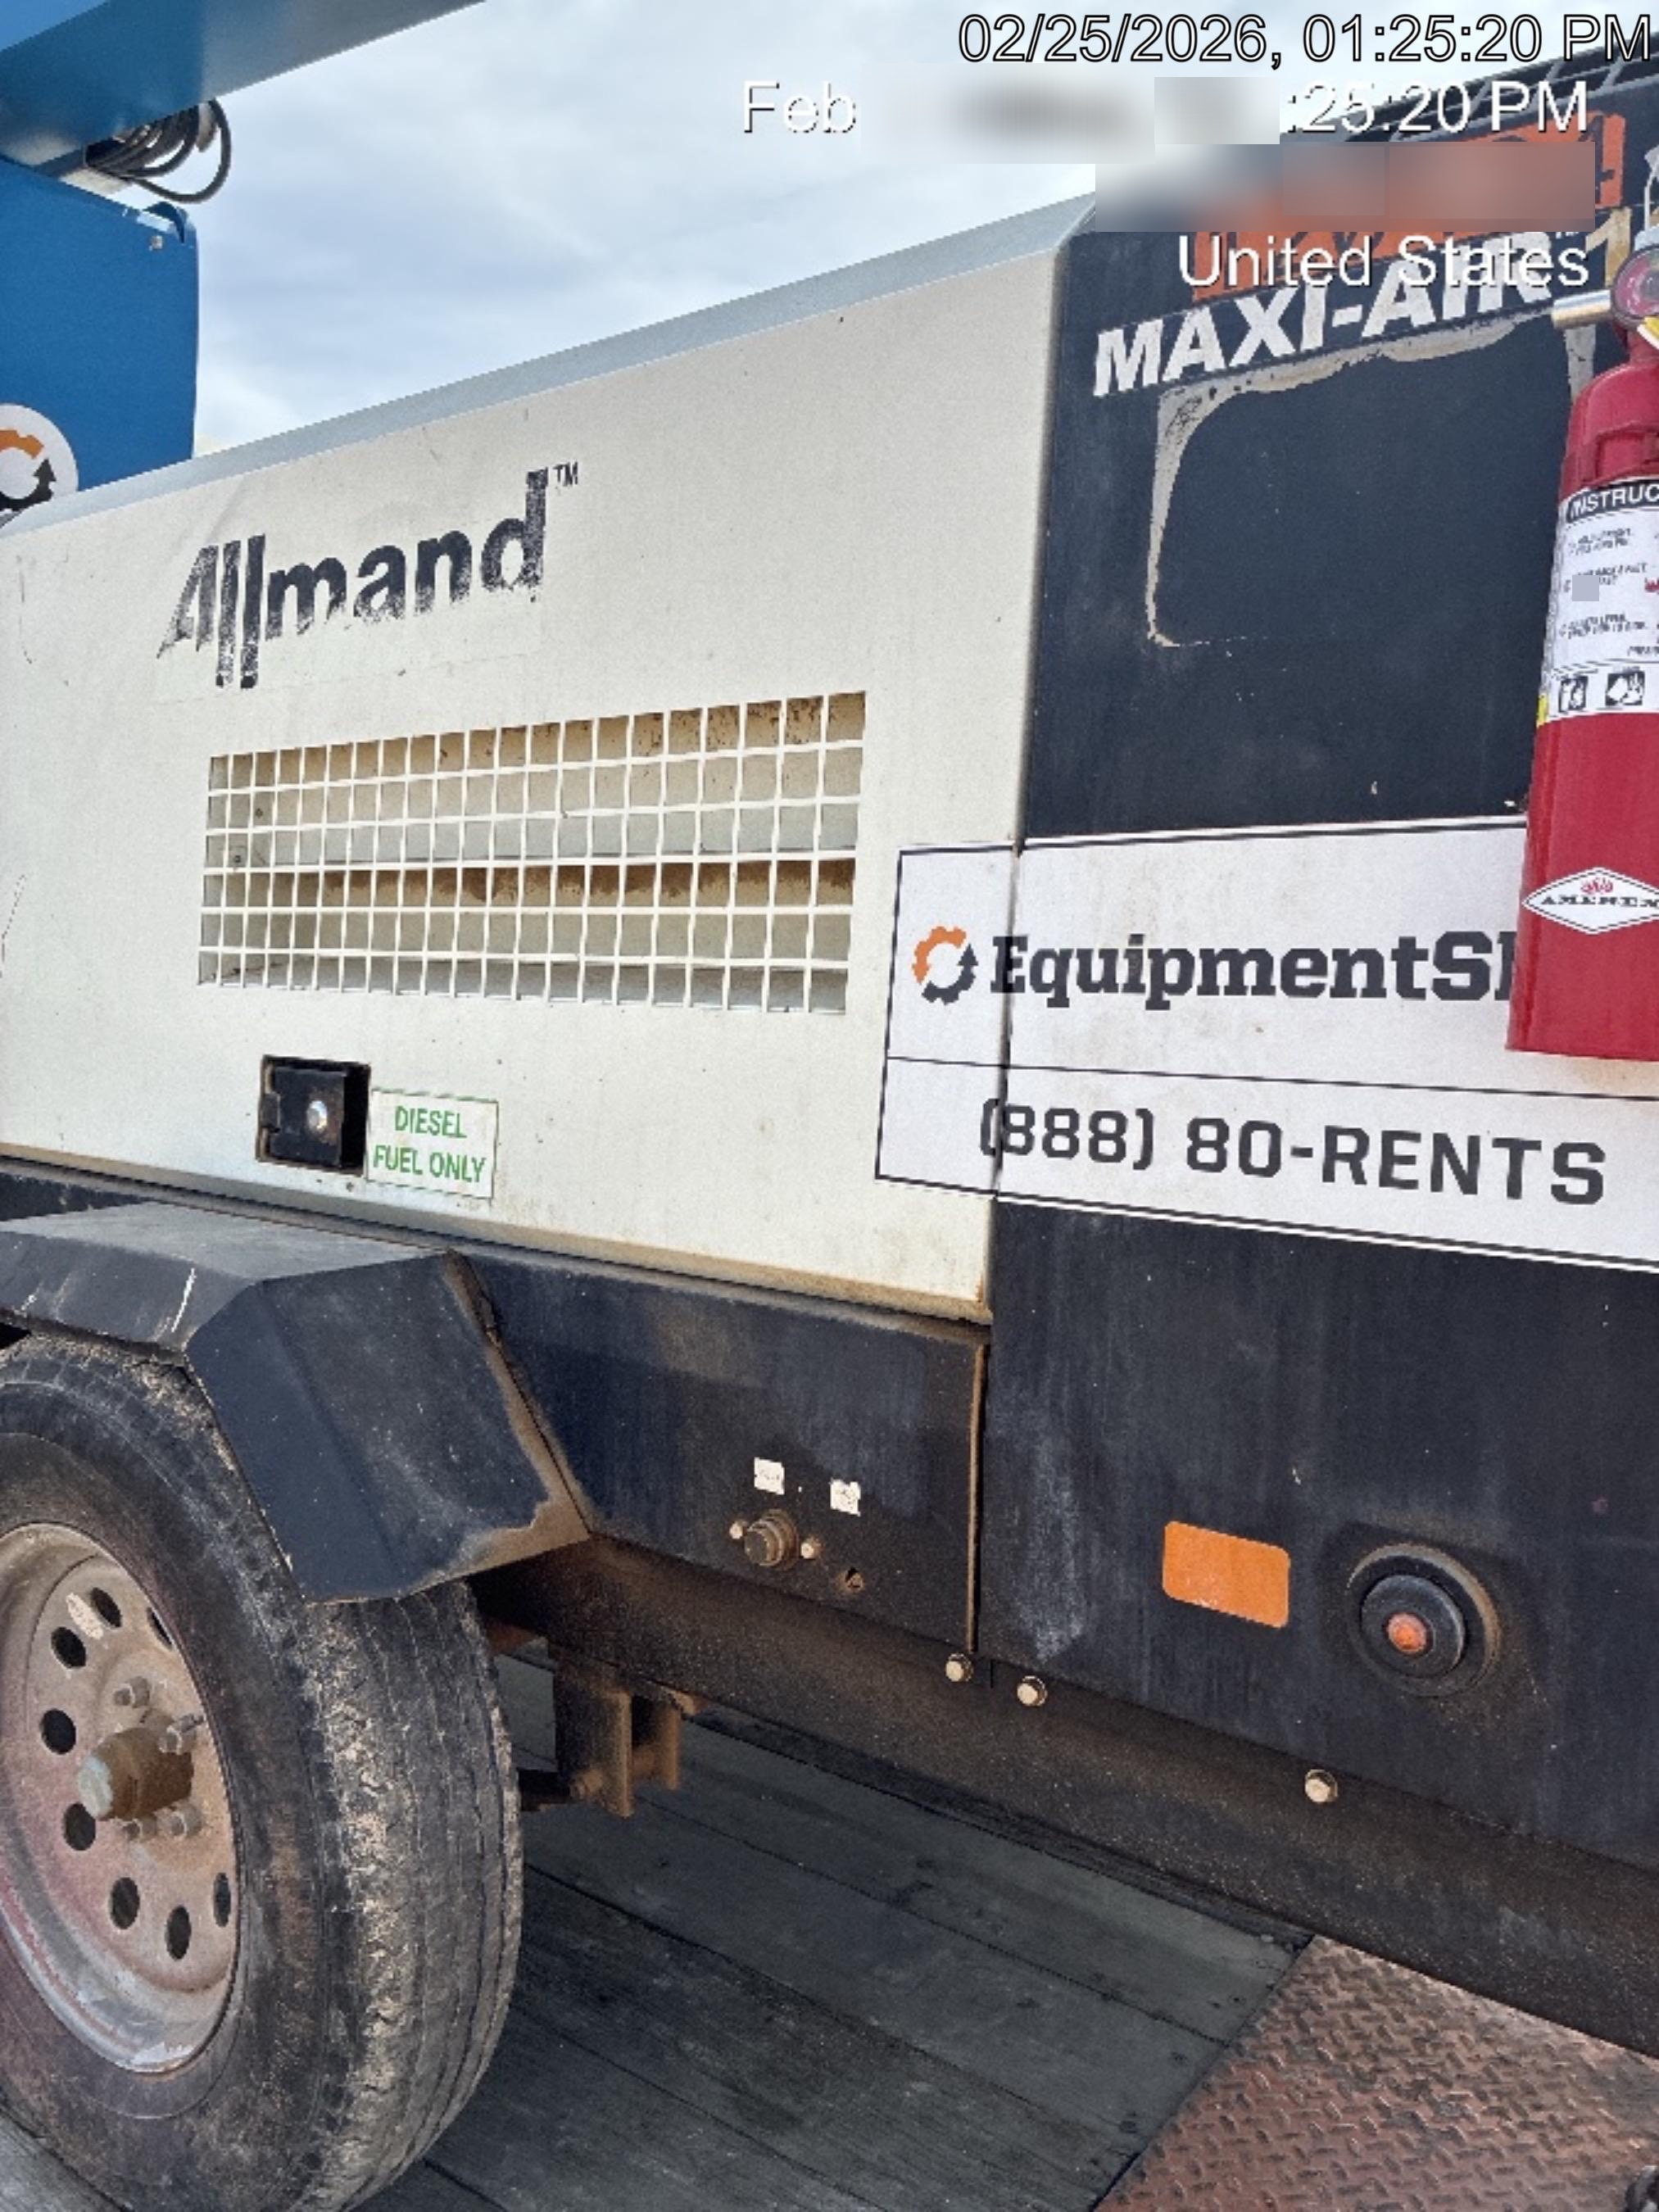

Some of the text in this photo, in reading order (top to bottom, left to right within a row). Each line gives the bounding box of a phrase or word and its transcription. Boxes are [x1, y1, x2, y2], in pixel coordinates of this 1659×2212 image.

[1093, 232, 1553, 398] MAXI-AIR
[156, 467, 547, 690] Allmand
[373, 1145, 487, 1183] FUEL ONLY
[395, 1105, 467, 1139] DIESEL
[981, 1098, 1606, 1205] (888) 80-RENTS
